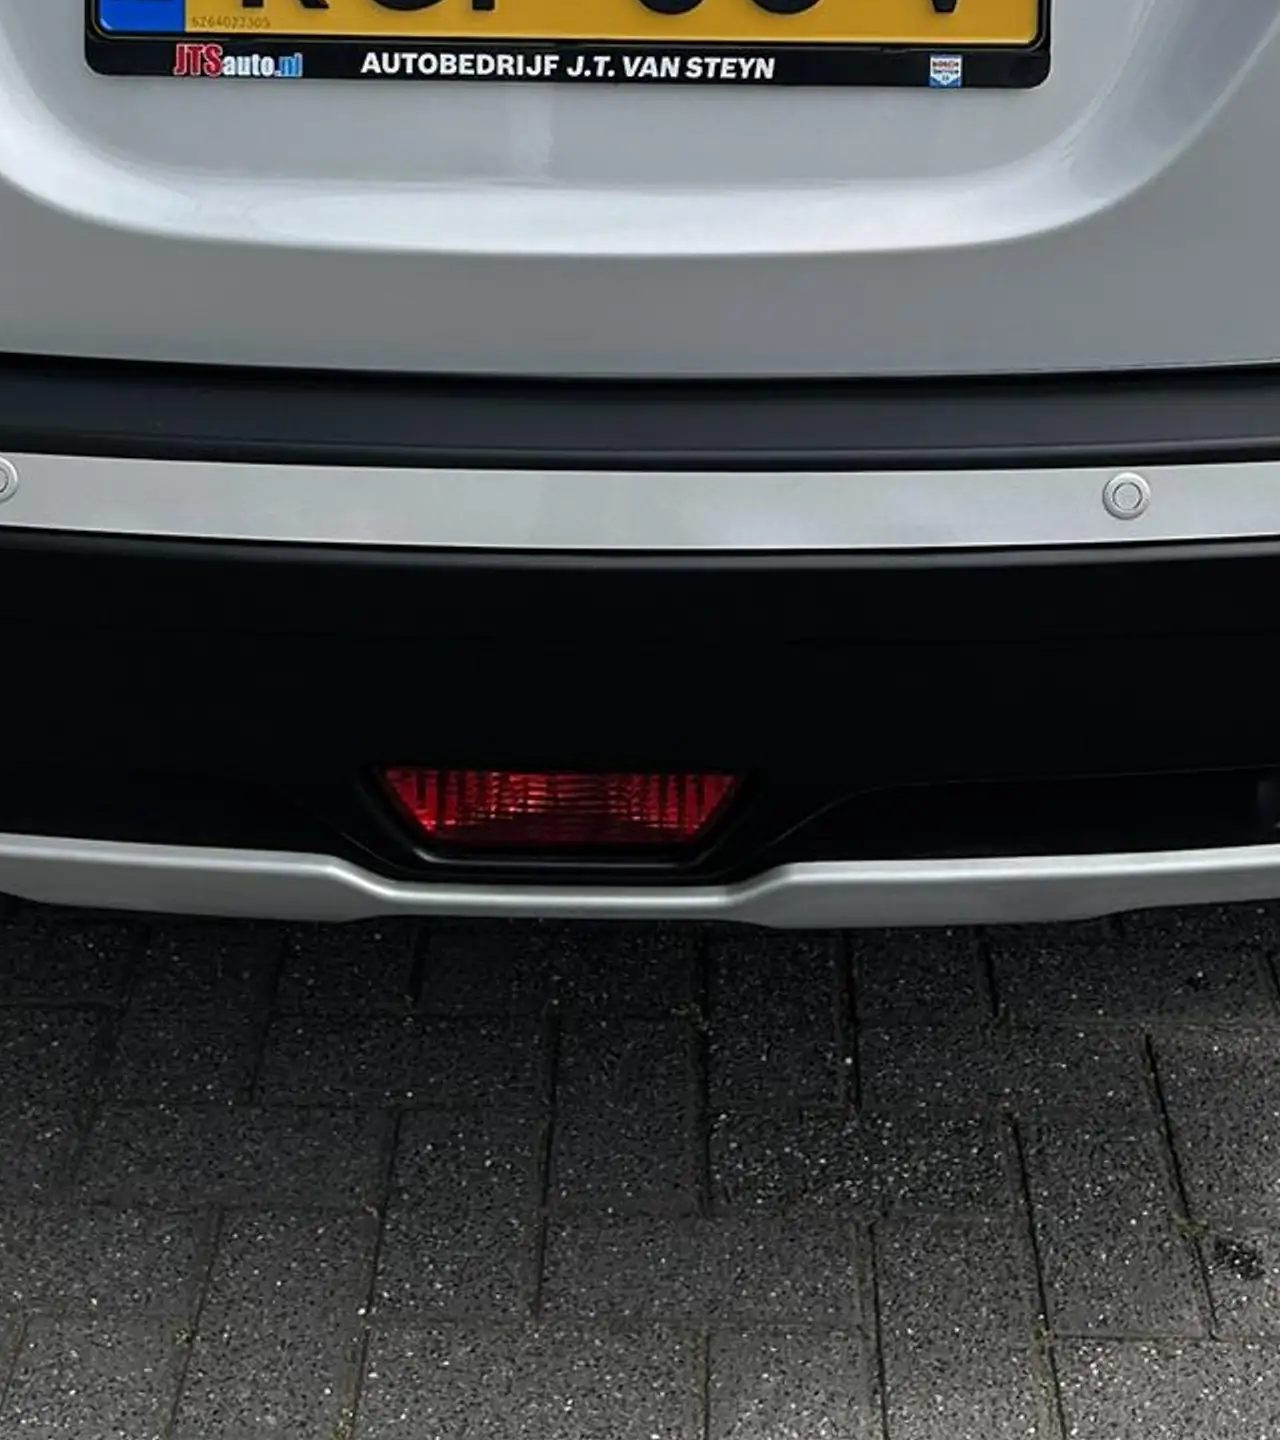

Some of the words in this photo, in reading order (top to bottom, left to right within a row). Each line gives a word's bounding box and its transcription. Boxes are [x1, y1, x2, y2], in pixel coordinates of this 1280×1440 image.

[173, 43, 304, 78] JTSauto.nl
[360, 51, 560, 77] AUTOBEDRIJF
[566, 54, 616, 78] J.T.
[623, 55, 680, 79] VAN
[685, 56, 776, 80] STEYN
